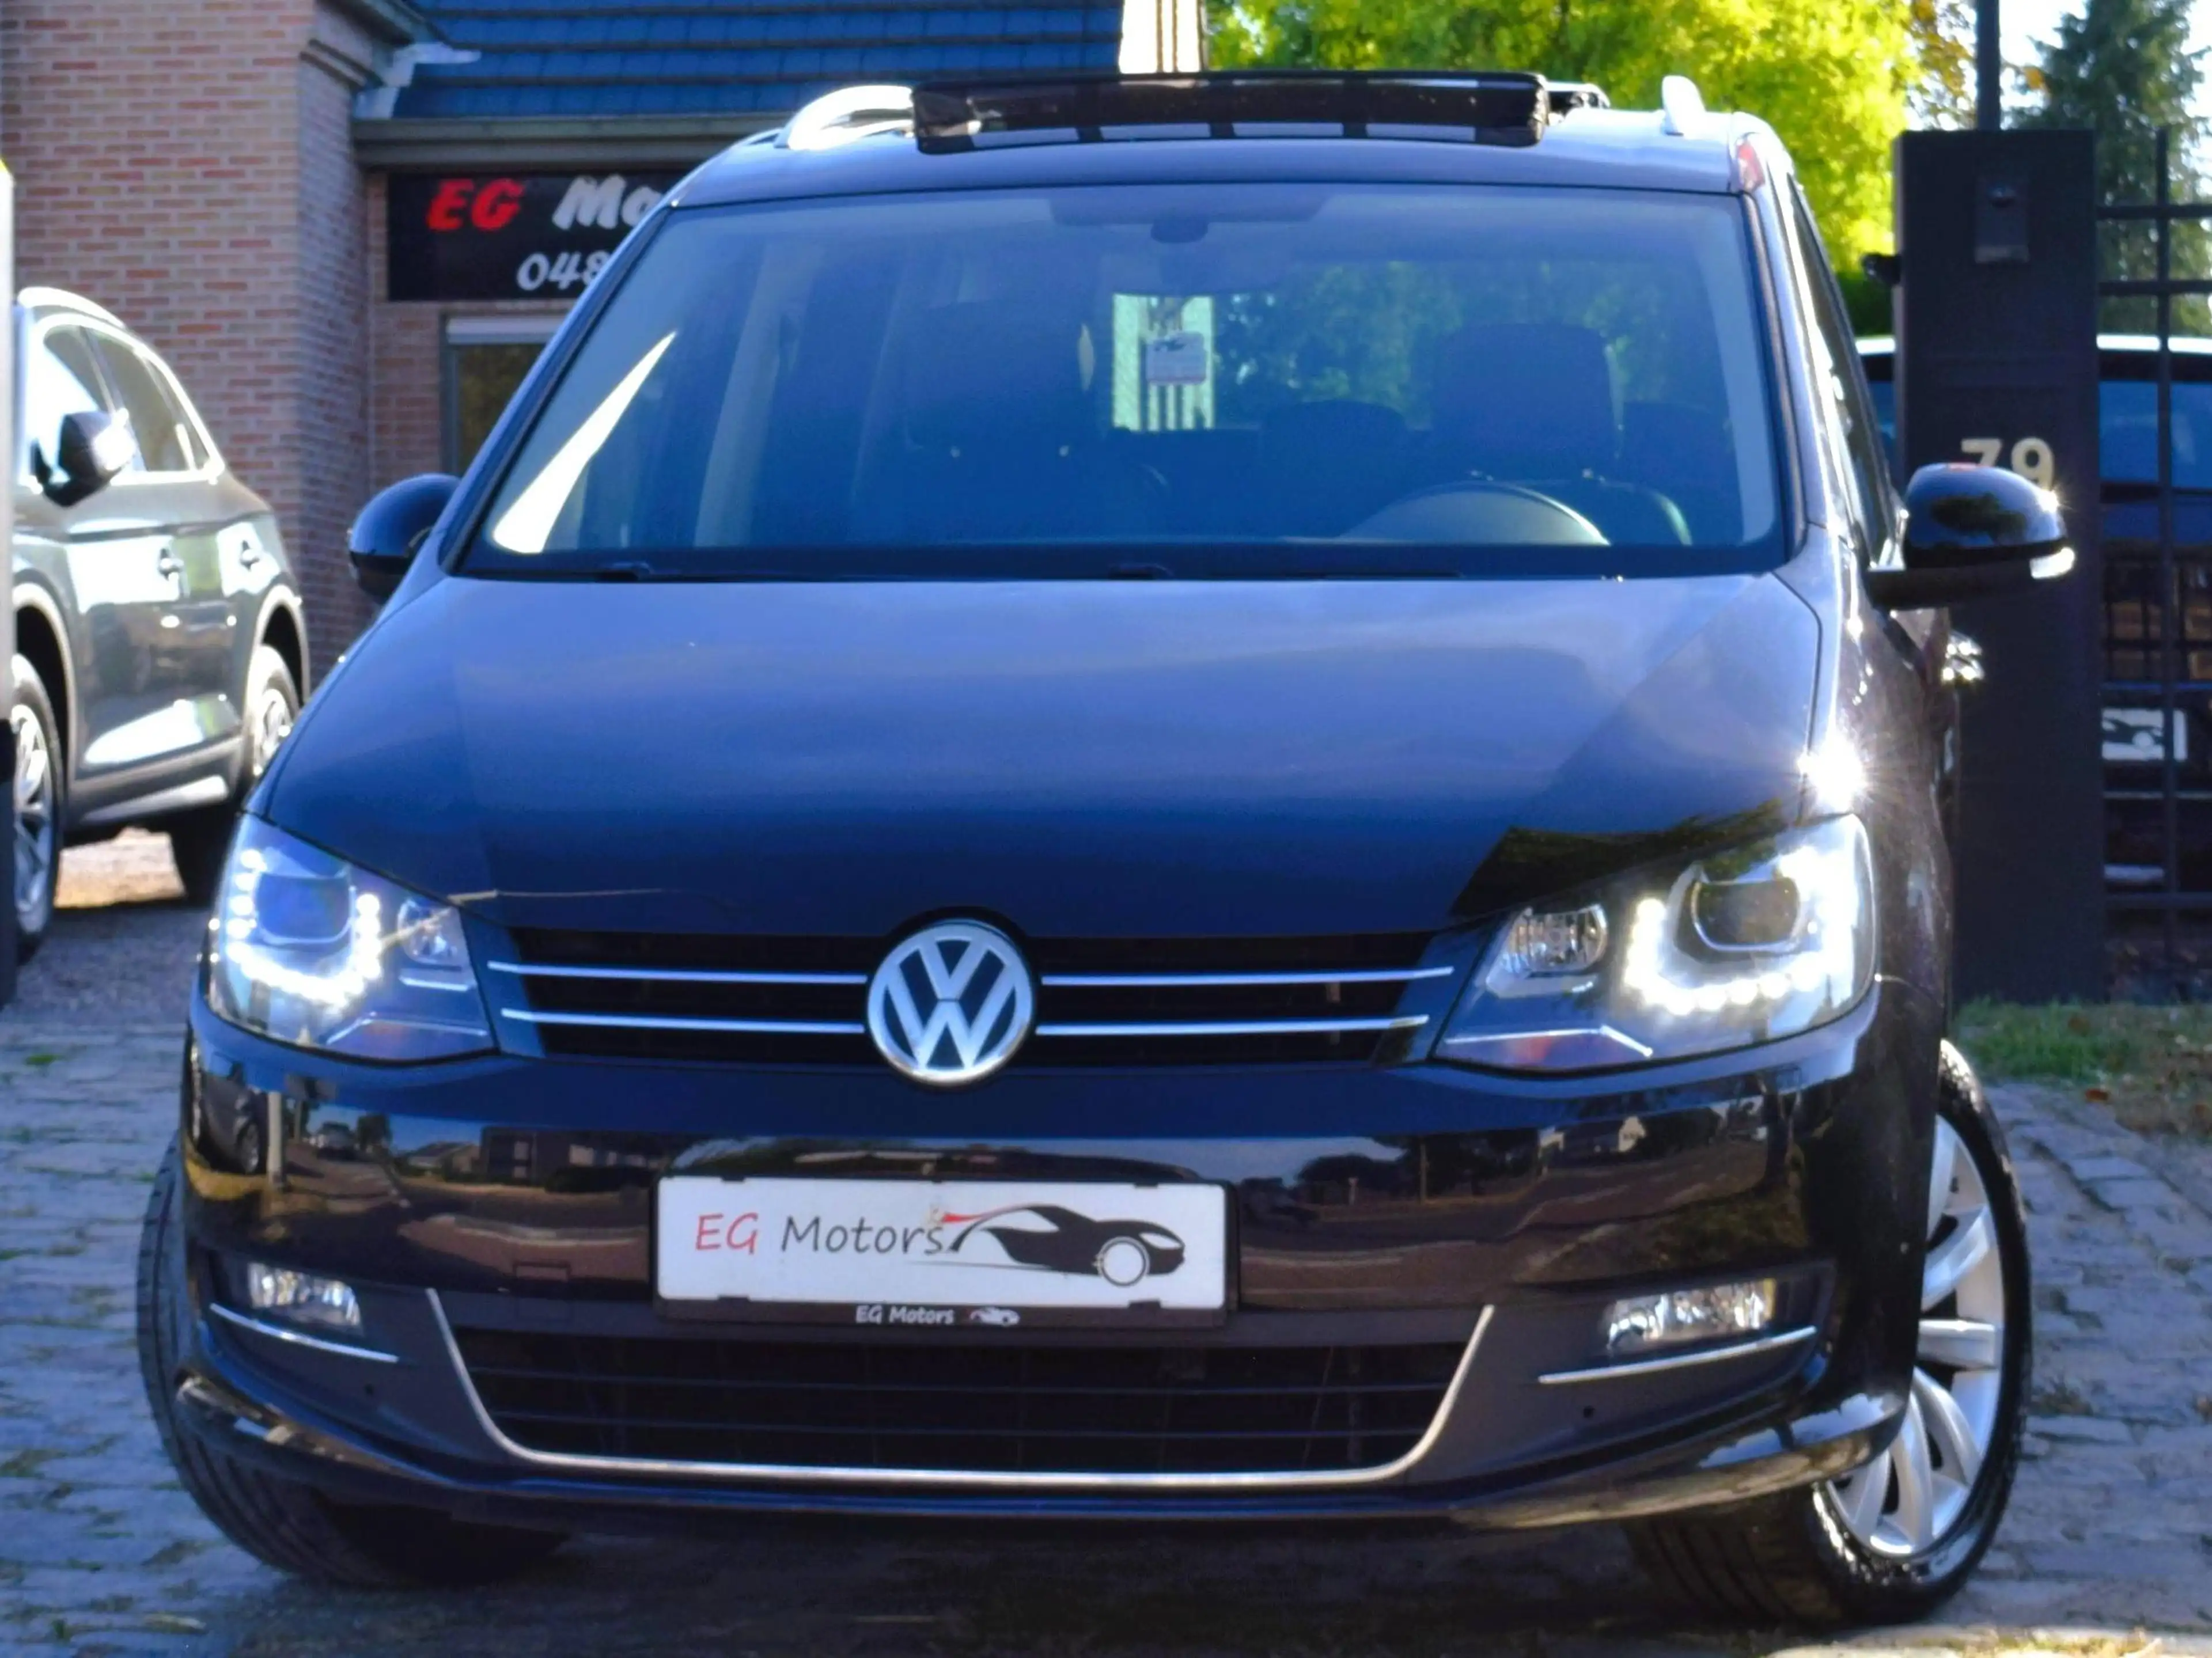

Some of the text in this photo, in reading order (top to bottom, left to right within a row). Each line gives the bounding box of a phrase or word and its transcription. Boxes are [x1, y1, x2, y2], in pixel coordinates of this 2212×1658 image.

[426, 177, 525, 230] EG
[873, 925, 1027, 1079] VW
[695, 1212, 944, 1255] EG Motors
[855, 1304, 955, 1325] EG Motors
